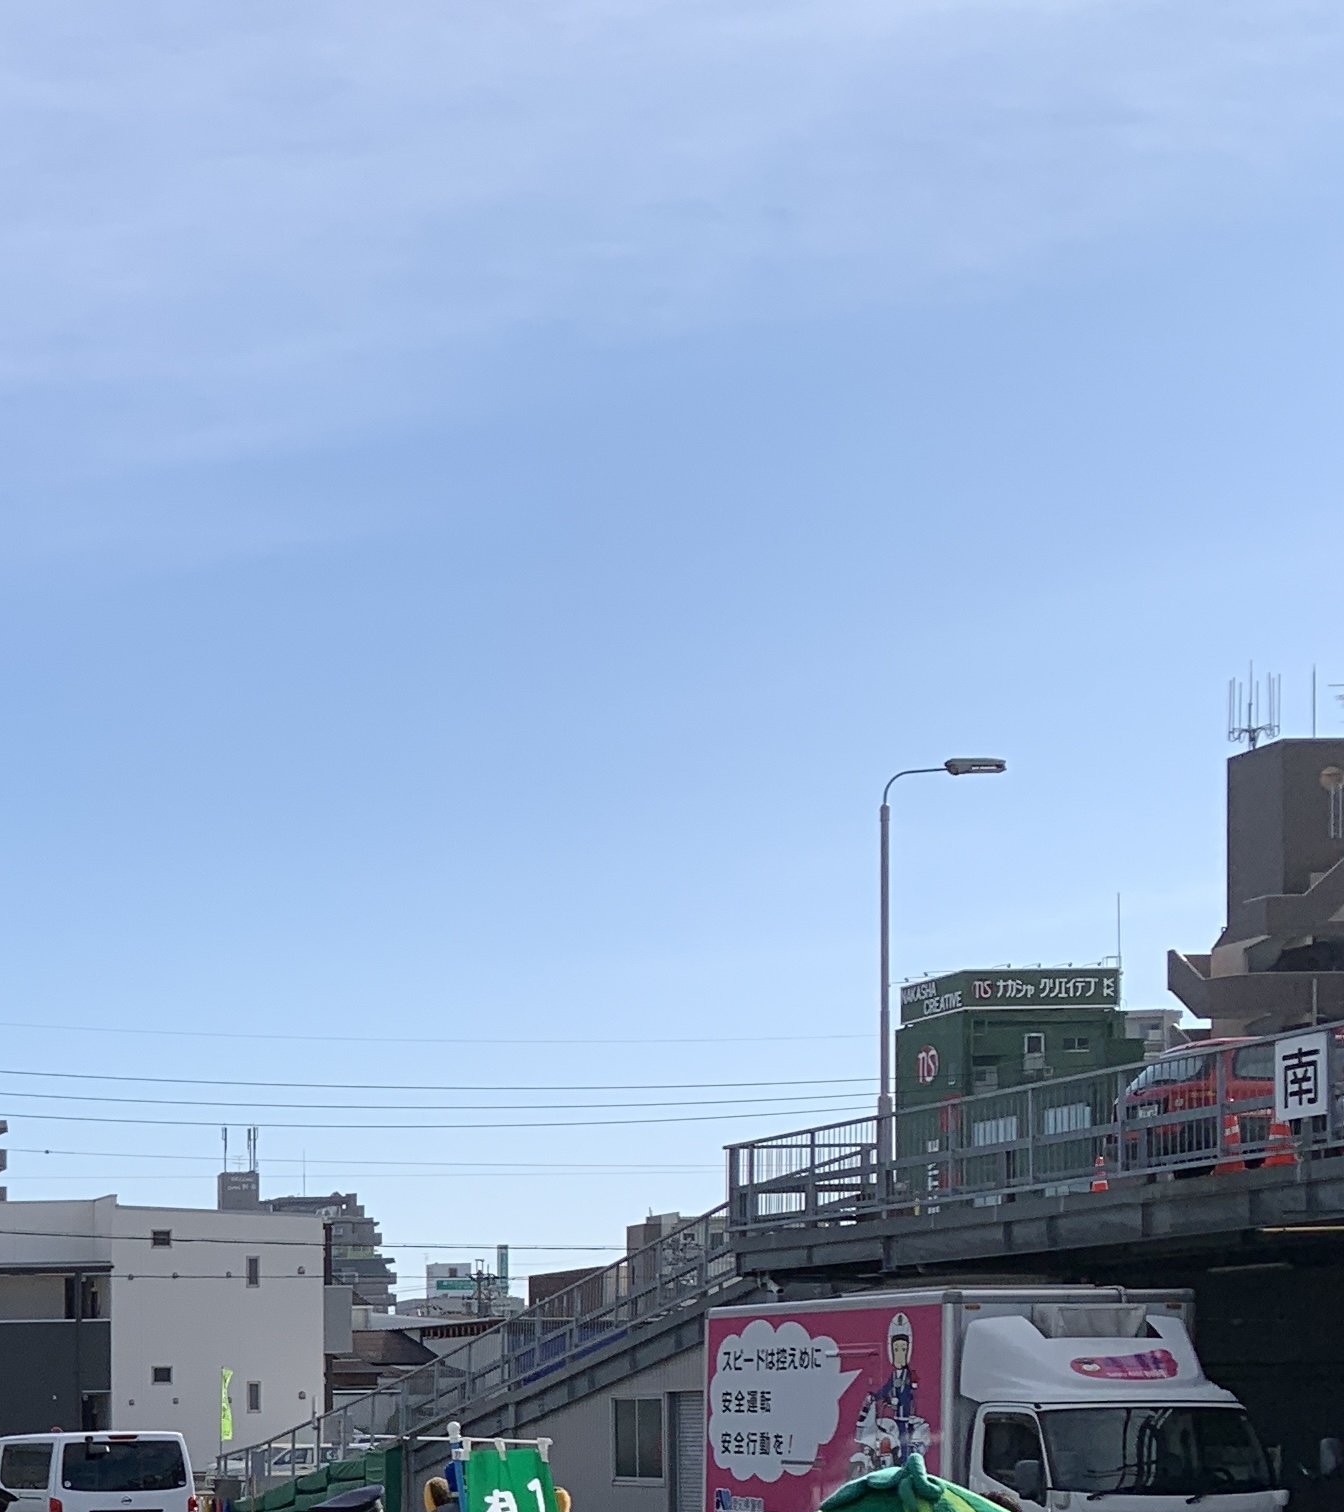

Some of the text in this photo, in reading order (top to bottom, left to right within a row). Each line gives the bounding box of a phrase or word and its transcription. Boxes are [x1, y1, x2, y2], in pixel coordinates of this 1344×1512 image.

[901, 981, 937, 1005] NAKASHA
[923, 990, 962, 1014] CREATIVE
[1281, 1046, 1321, 1110] 南
[722, 1347, 822, 1372] スピードは控えめに
[721, 1390, 772, 1414] 安全運転
